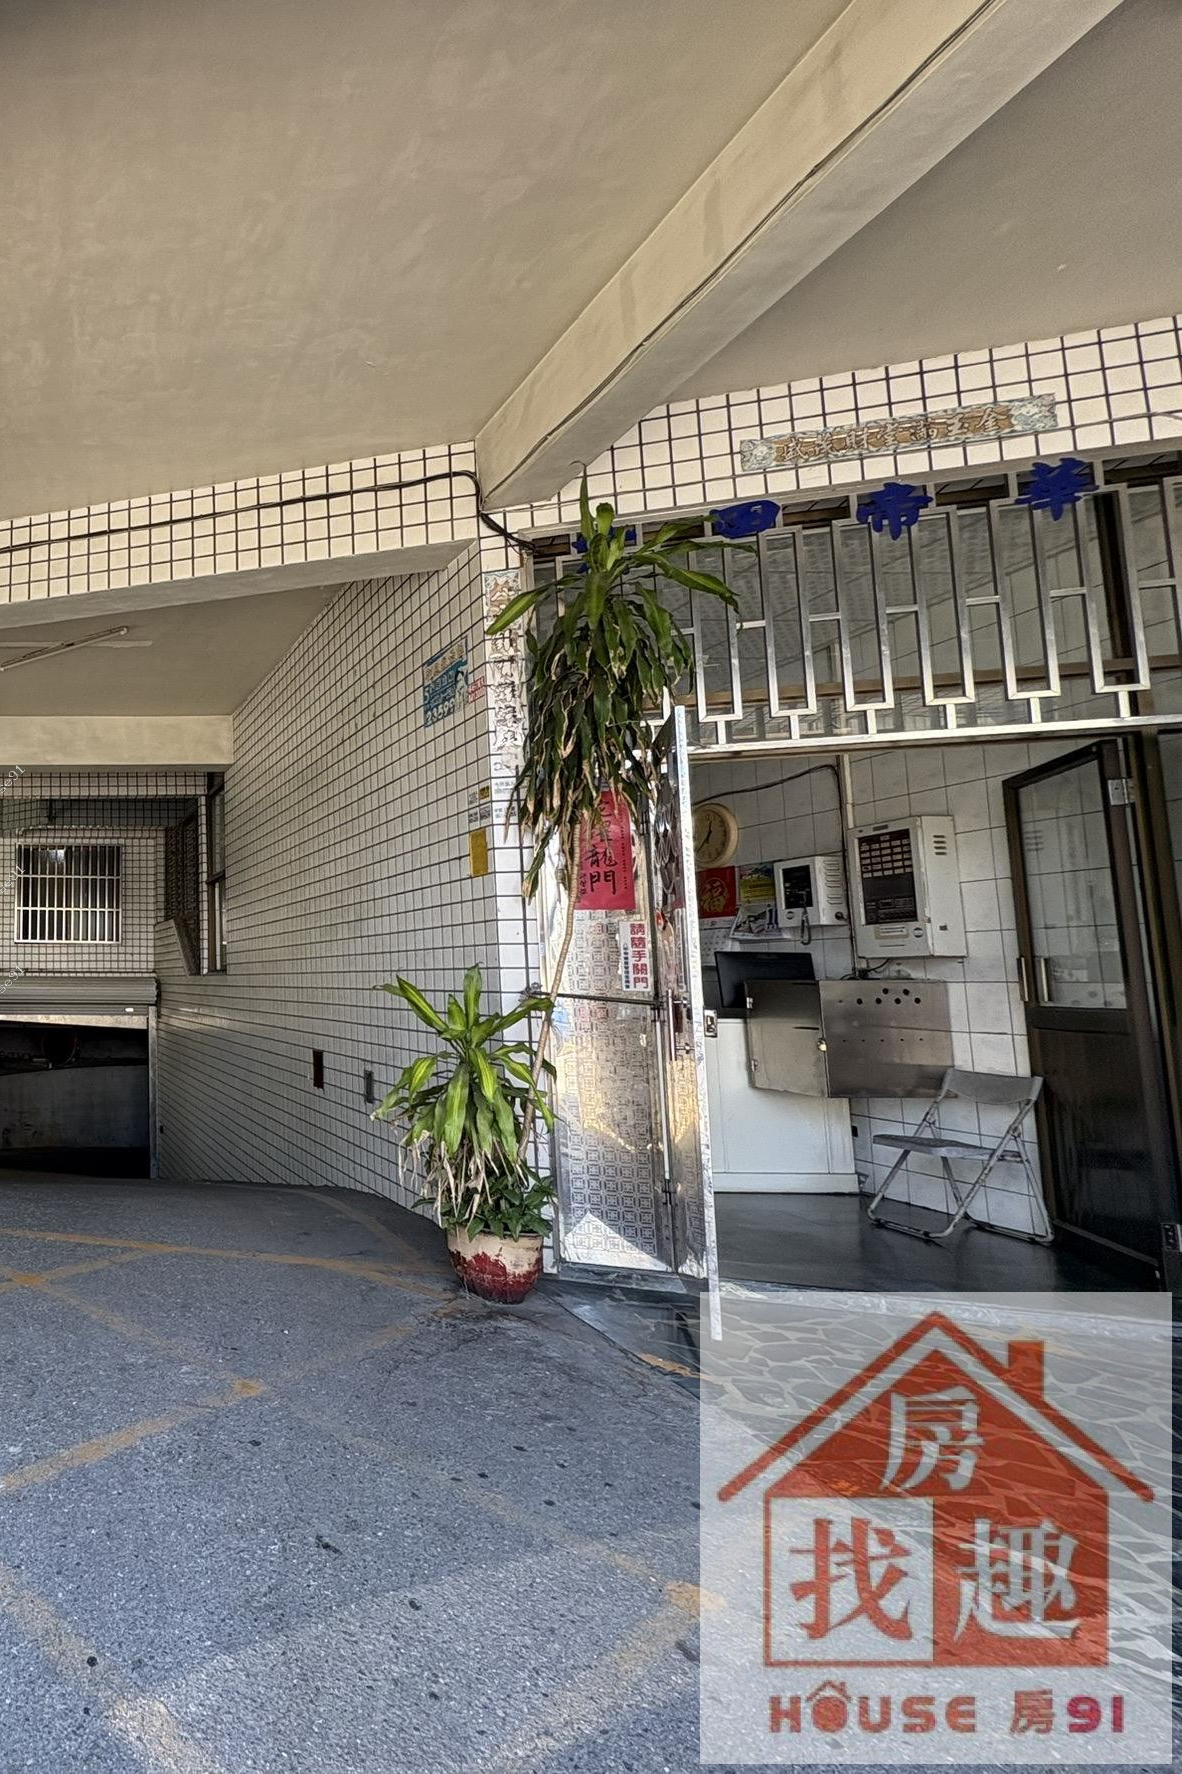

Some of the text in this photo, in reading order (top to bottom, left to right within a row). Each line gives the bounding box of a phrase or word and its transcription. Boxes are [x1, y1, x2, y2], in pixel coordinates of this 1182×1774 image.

[630, 923, 648, 989] 請隨手關門
